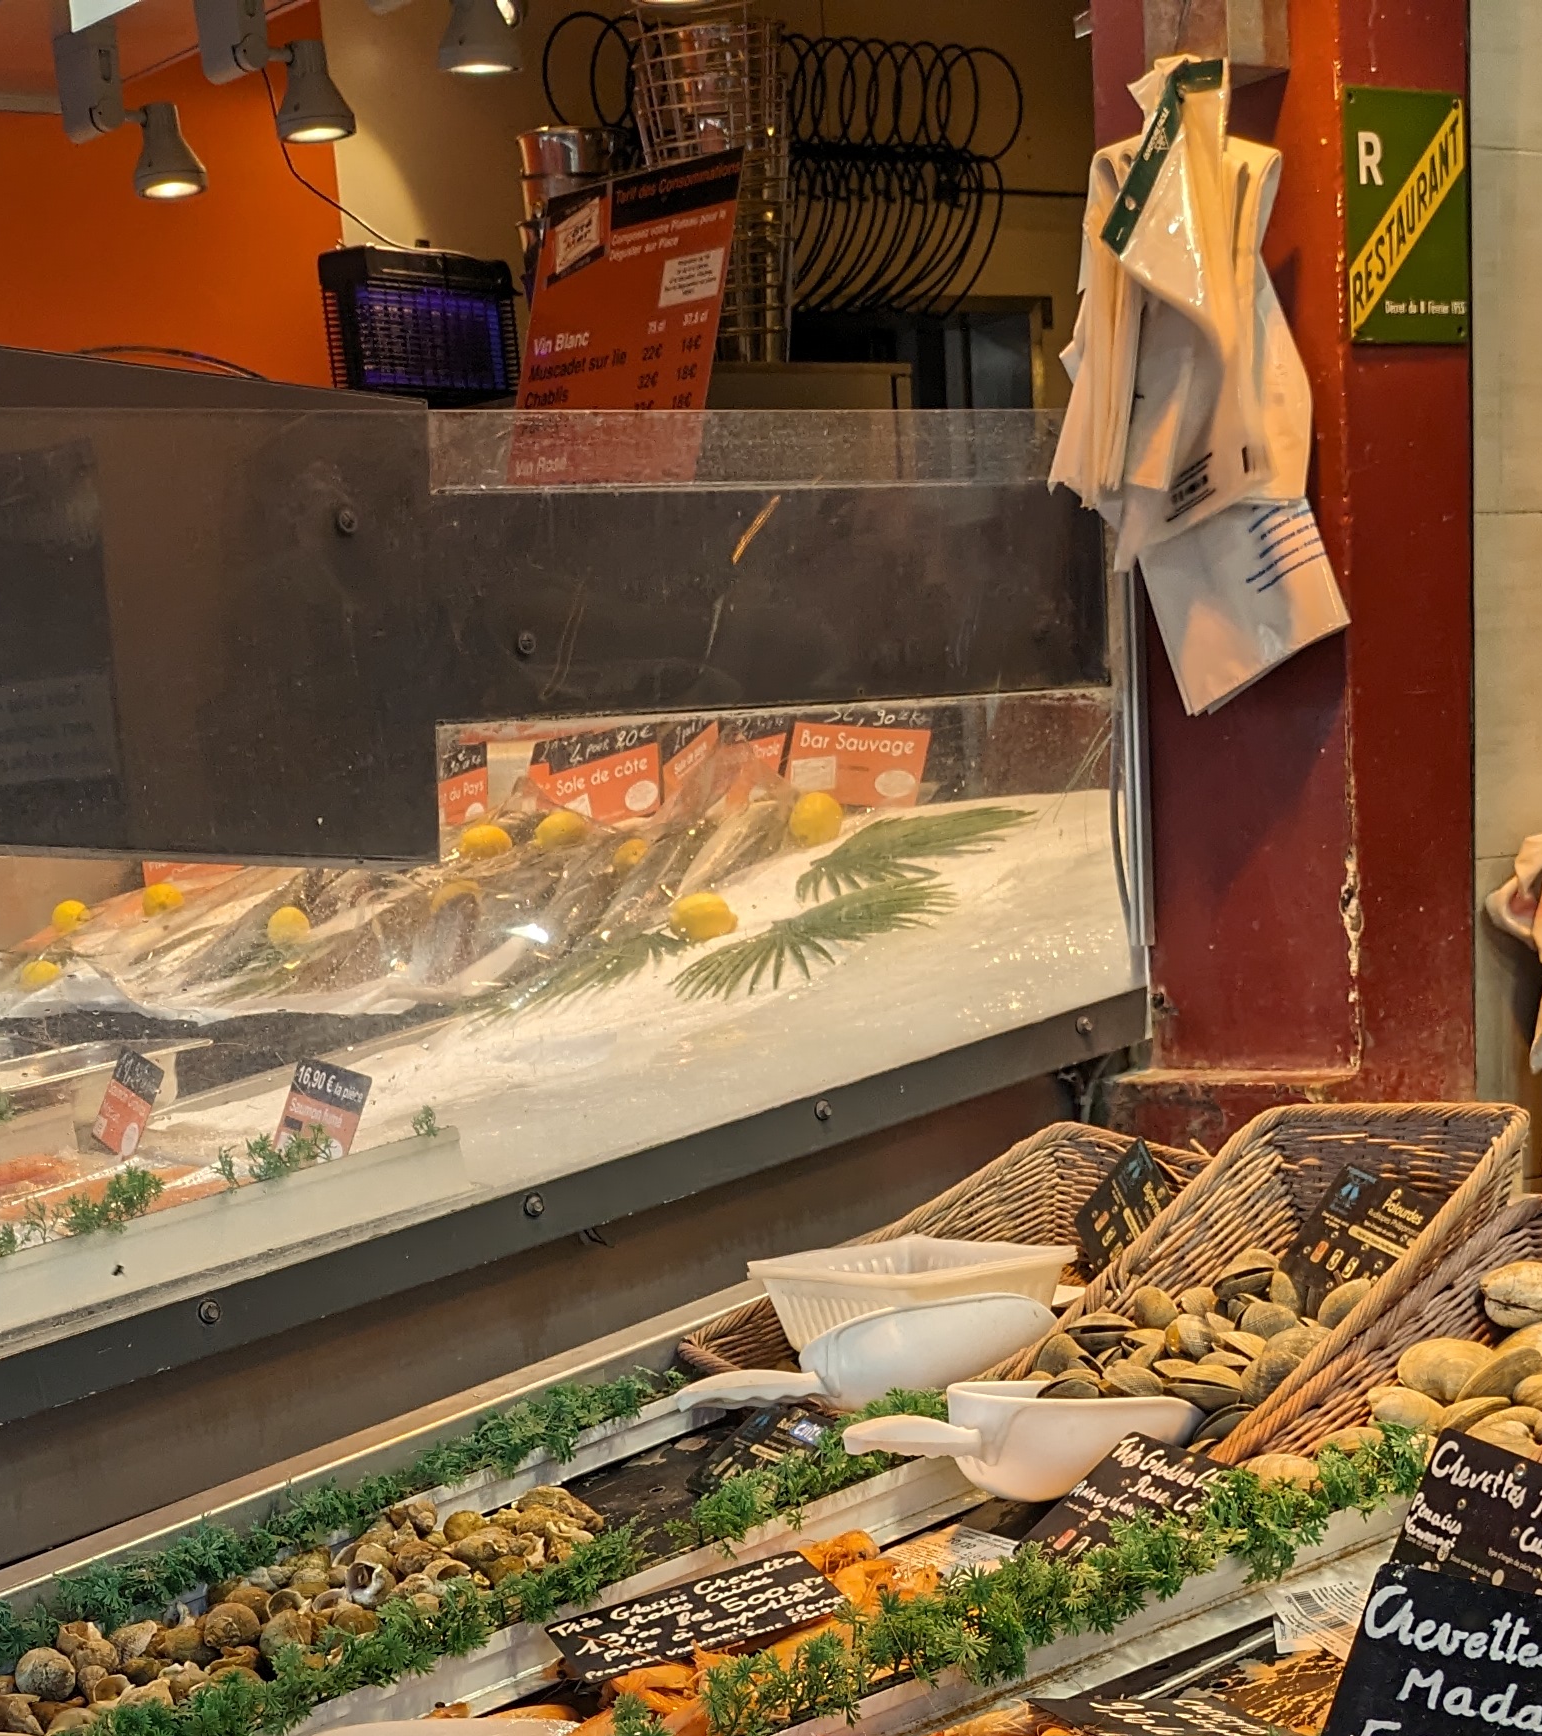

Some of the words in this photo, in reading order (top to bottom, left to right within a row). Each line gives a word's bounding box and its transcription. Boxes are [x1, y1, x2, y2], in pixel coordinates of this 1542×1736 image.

[1358, 131, 1385, 186] R
[639, 185, 657, 199] des
[1352, 115, 1460, 323] RESTAURANT
[533, 337, 553, 357] Vin
[555, 331, 590, 352] Blanc
[528, 357, 587, 383] Muscadet
[588, 355, 609, 371] sur
[642, 343, 663, 362] 22€
[524, 387, 569, 410] Chablis
[800, 730, 831, 749] Bar
[834, 731, 916, 757] Sauvage
[462, 777, 486, 799] Pays
[556, 775, 586, 798] Sole
[590, 769, 610, 787] de
[614, 757, 649, 780] côte
[297, 1064, 326, 1090] 16,90
[325, 1075, 337, 1094] €
[289, 1097, 322, 1123] Saumon
[1382, 1198, 1425, 1226] Palourdes
[1110, 1435, 1142, 1469] Très
[549, 1616, 605, 1638] Très
[609, 1592, 689, 1622] Grosses
[629, 1601, 694, 1627] Roses
[705, 1576, 775, 1604] Cuites
[676, 1610, 714, 1628] les
